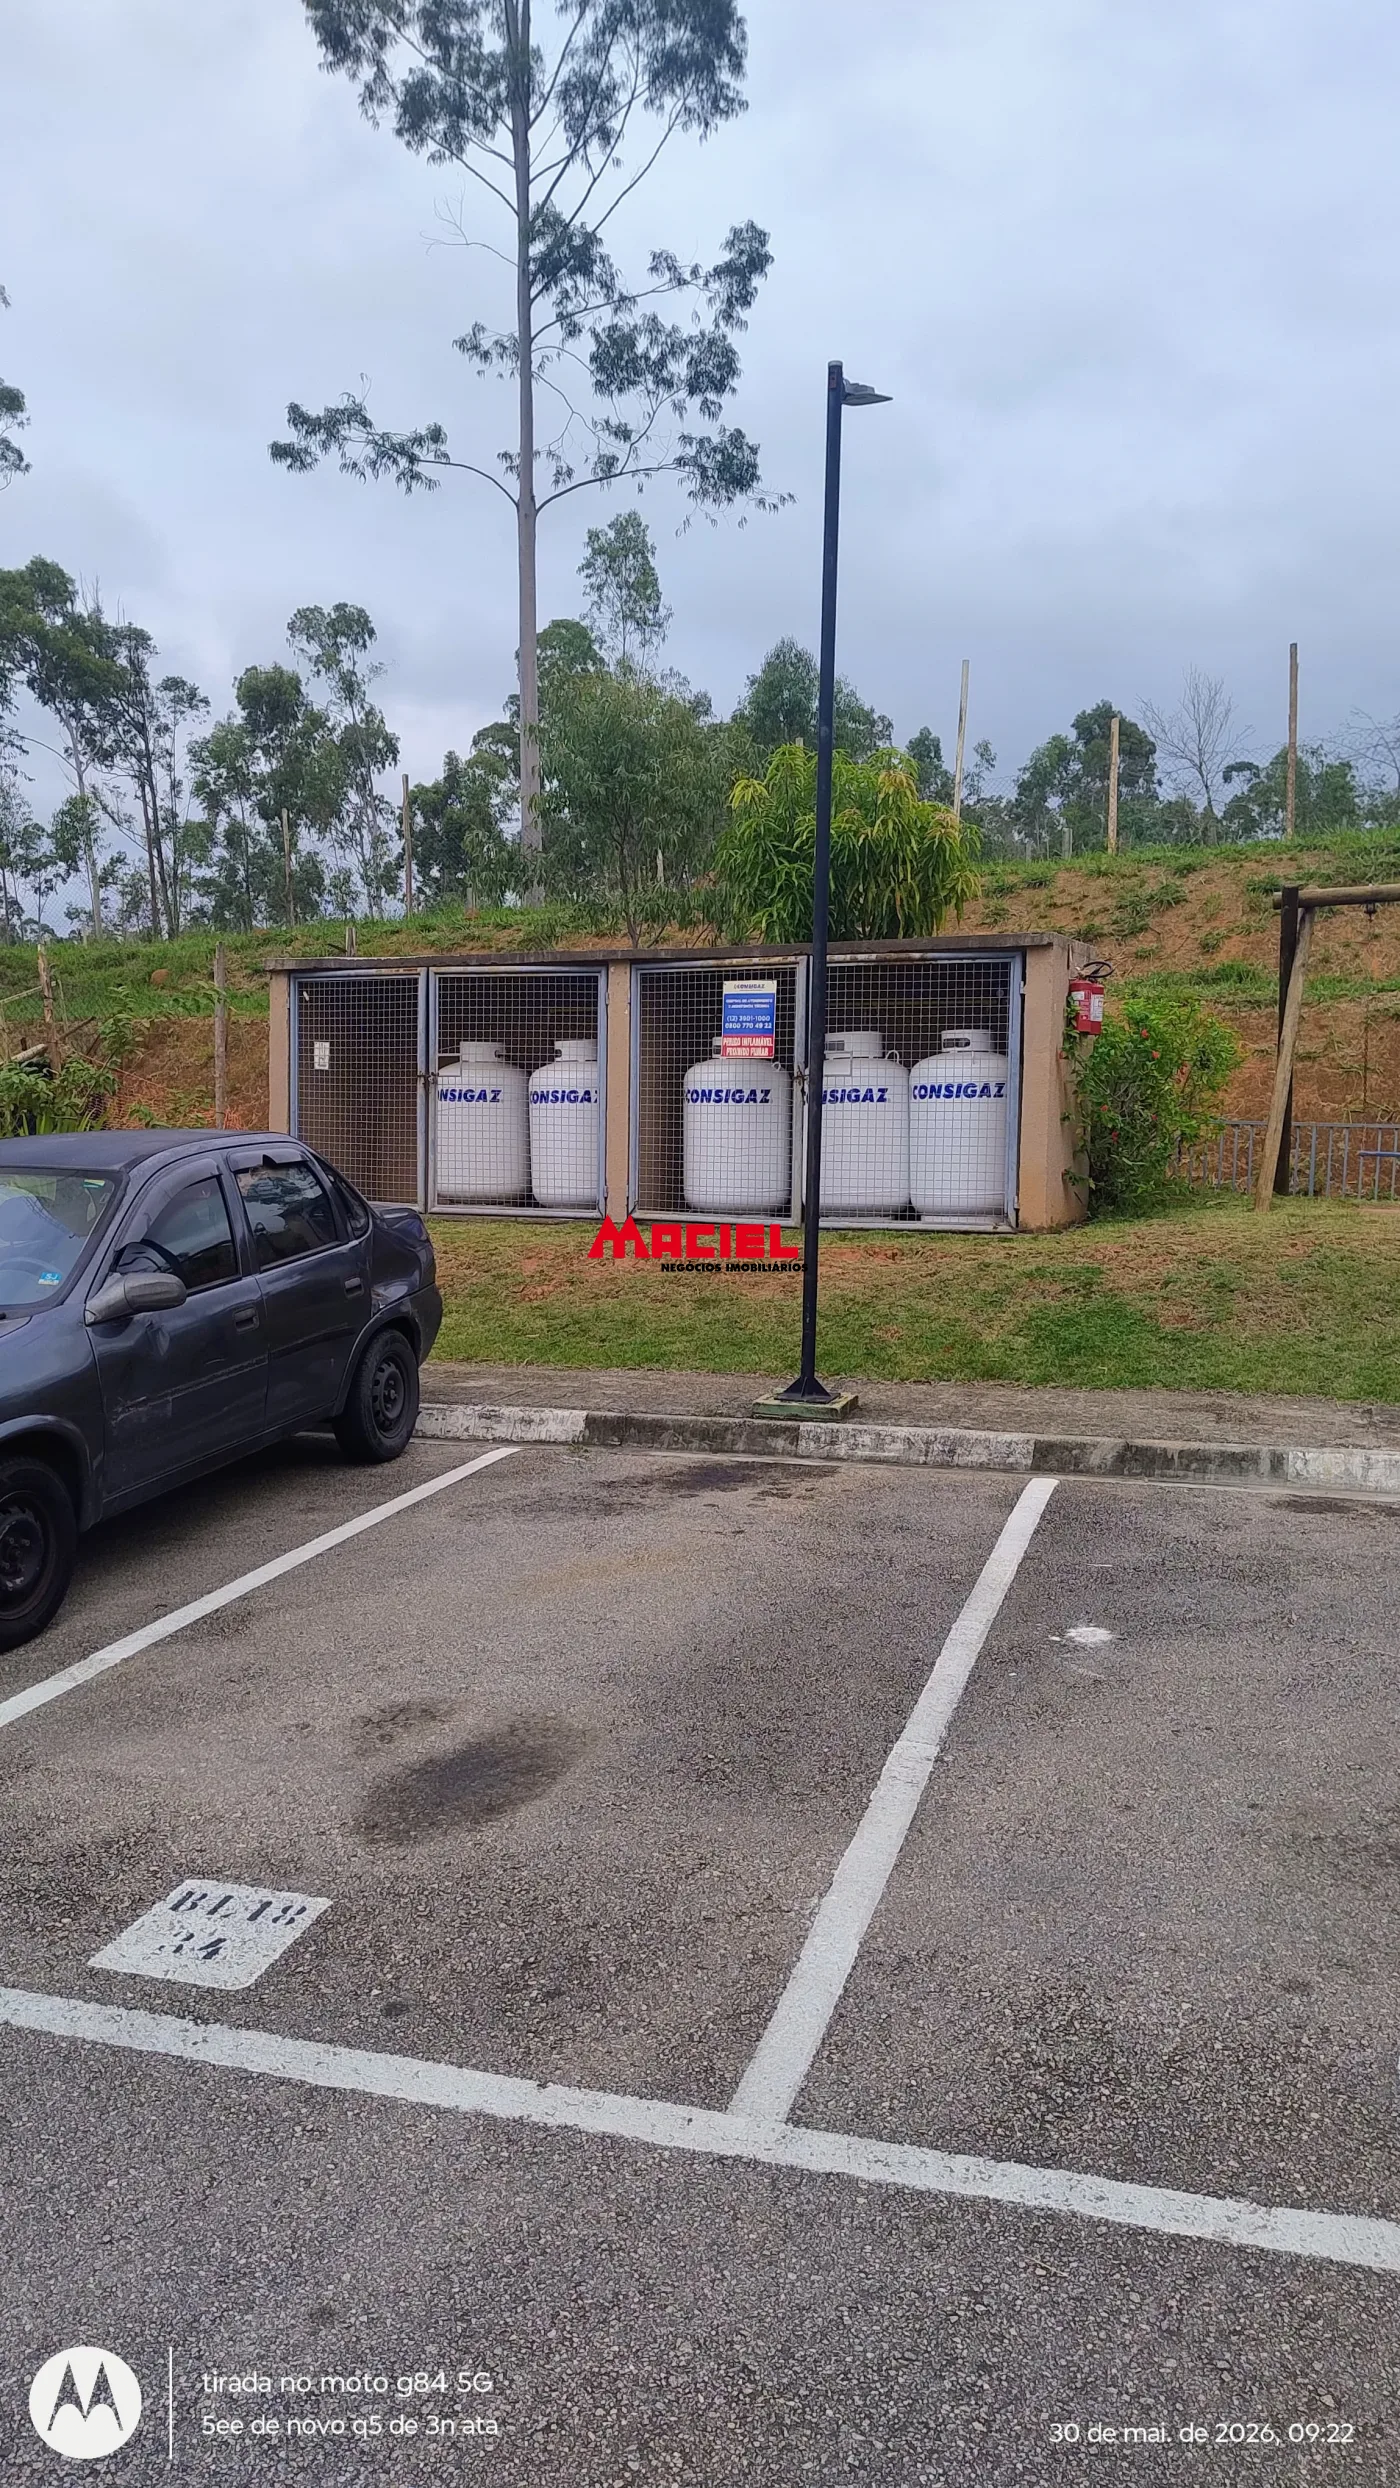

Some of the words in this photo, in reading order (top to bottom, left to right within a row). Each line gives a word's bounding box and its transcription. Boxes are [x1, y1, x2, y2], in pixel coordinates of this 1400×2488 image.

[437, 1088, 502, 1103] NSIGAZ
[685, 1088, 772, 1104] CONSIGAZ
[821, 1087, 889, 1105] SIGAZ
[912, 1082, 1006, 1100] CONSIGAZ
[246, 1901, 307, 1925] 18
